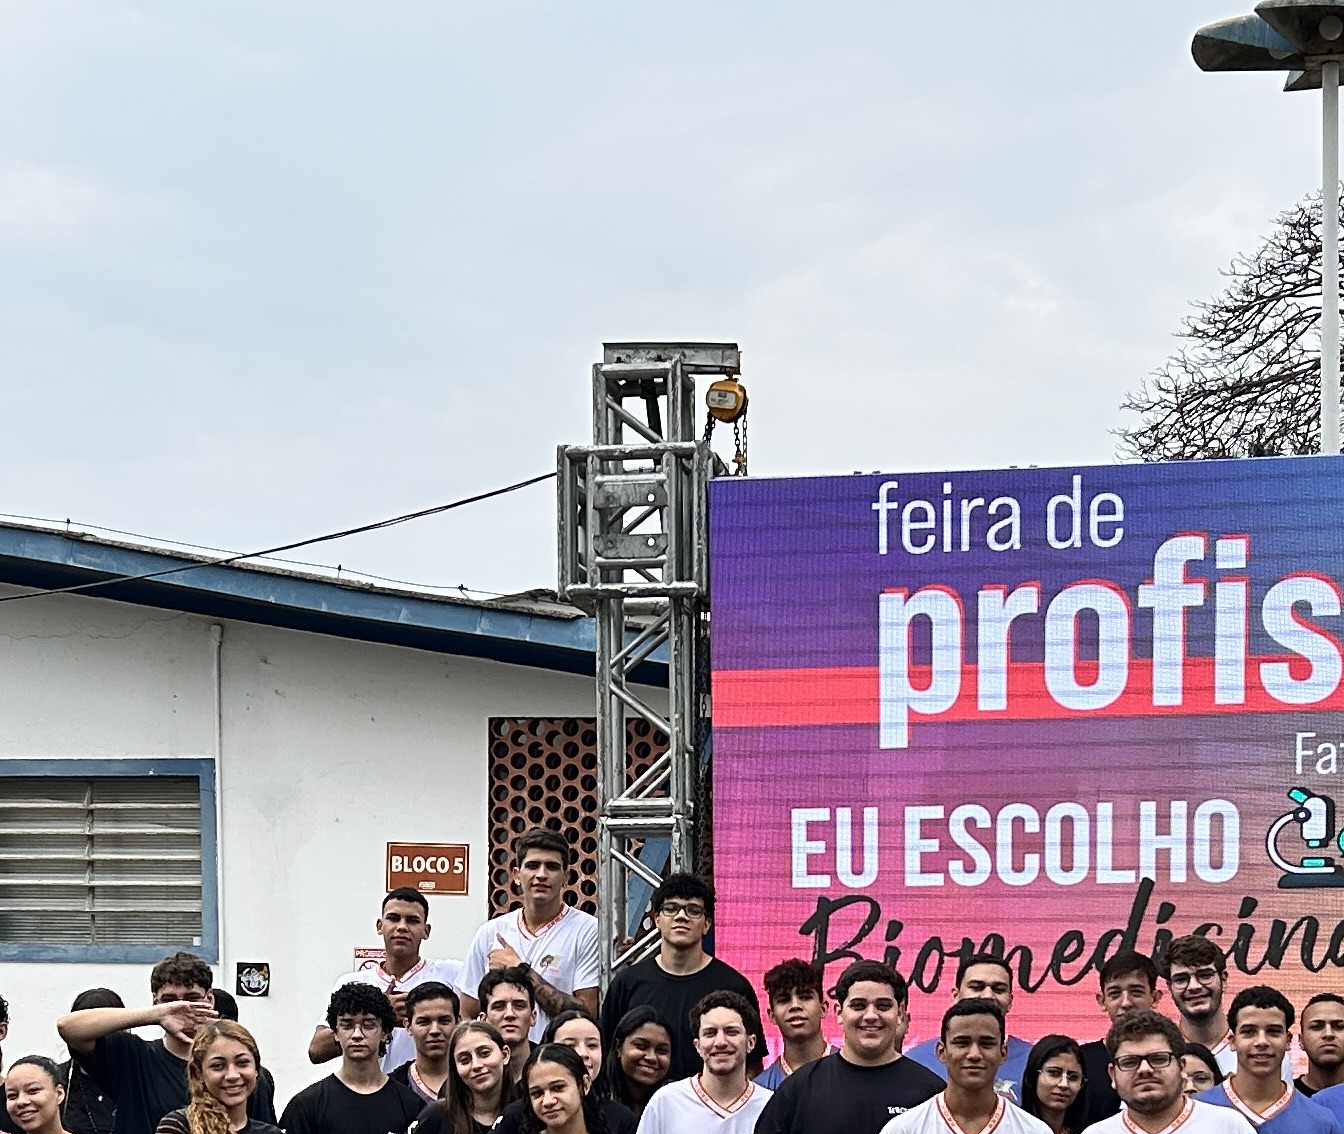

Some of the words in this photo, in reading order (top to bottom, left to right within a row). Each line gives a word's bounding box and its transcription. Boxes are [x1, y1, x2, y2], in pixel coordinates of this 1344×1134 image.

[871, 480, 1021, 555] feira
[1046, 474, 1125, 550] de
[391, 855, 450, 874] BLOCO
[452, 857, 464, 874] 5
[789, 806, 880, 889] EU
[904, 798, 1241, 887] ESCOLHO
